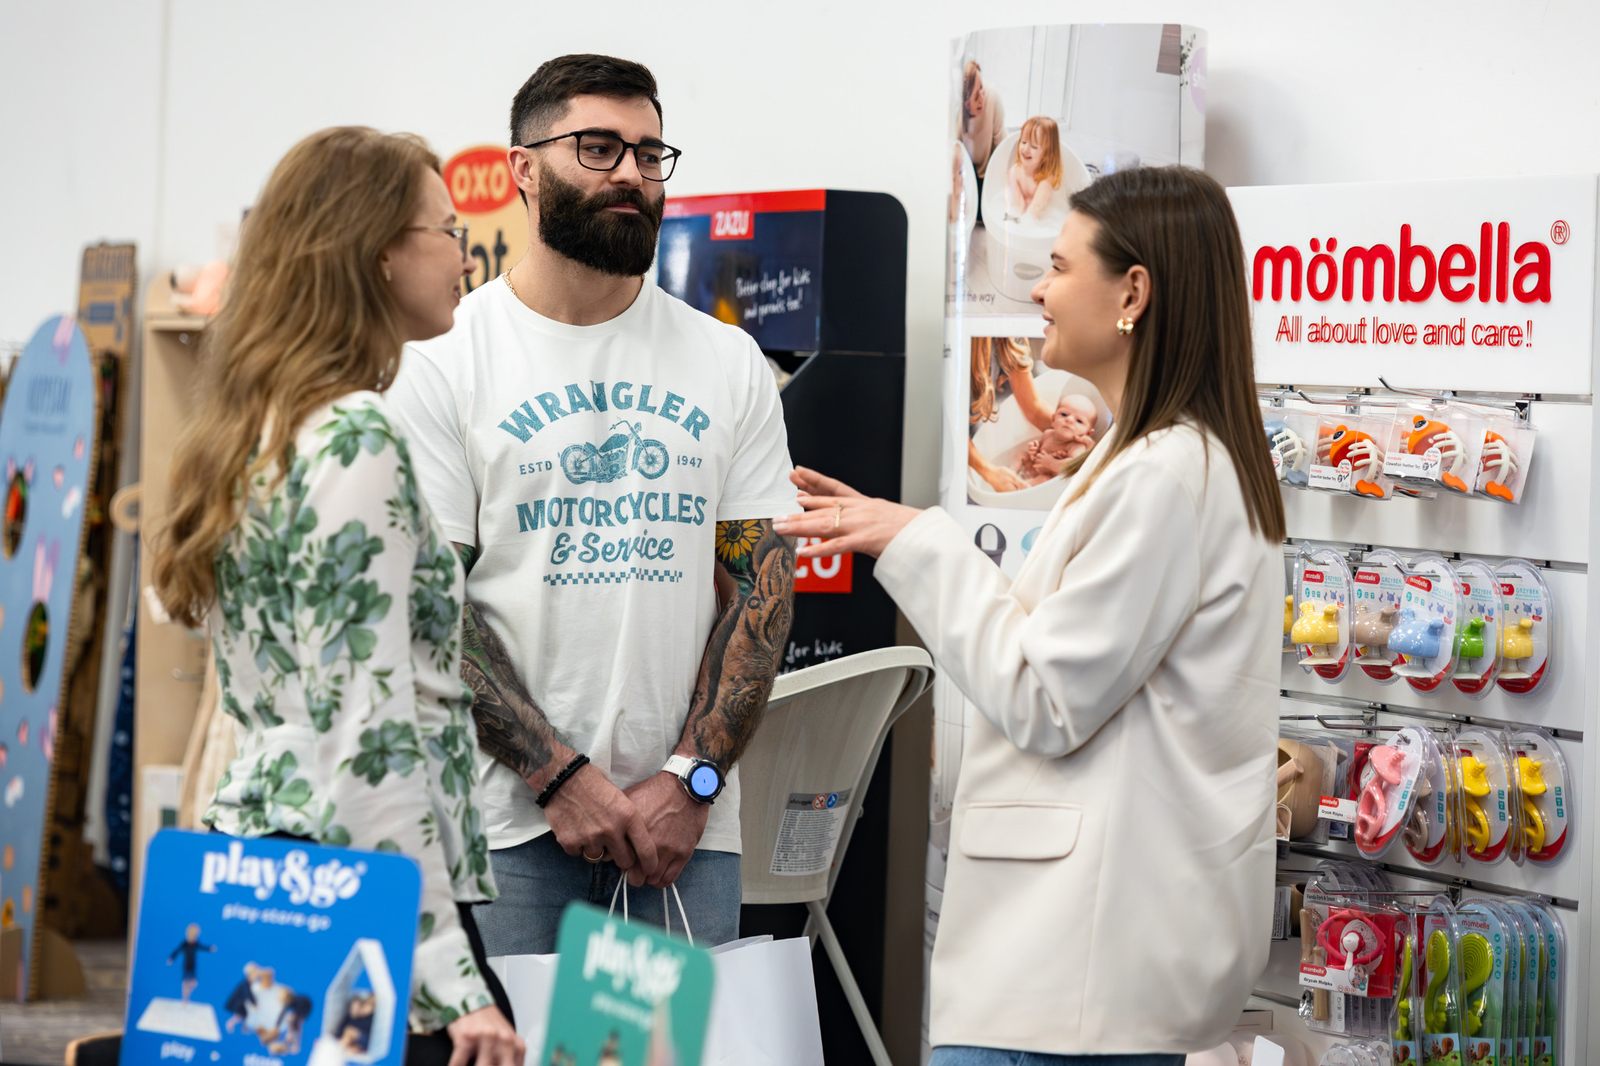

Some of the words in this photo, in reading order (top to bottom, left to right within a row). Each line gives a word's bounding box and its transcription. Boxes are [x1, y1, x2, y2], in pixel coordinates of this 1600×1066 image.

[452, 159, 509, 204] OXO
[714, 210, 750, 236] ZAZU
[1276, 315, 1303, 343] All
[1307, 316, 1368, 345] about
[1372, 316, 1418, 345] love
[1422, 317, 1466, 346] and
[1471, 319, 1534, 348] care!
[497, 380, 711, 444] WRANGLER
[519, 460, 553, 476] ESTD
[676, 454, 703, 469] 1947
[516, 491, 708, 533] MOTORCYCLES
[550, 531, 577, 566] &
[577, 529, 675, 565] Service
[814, 638, 843, 658] kids
